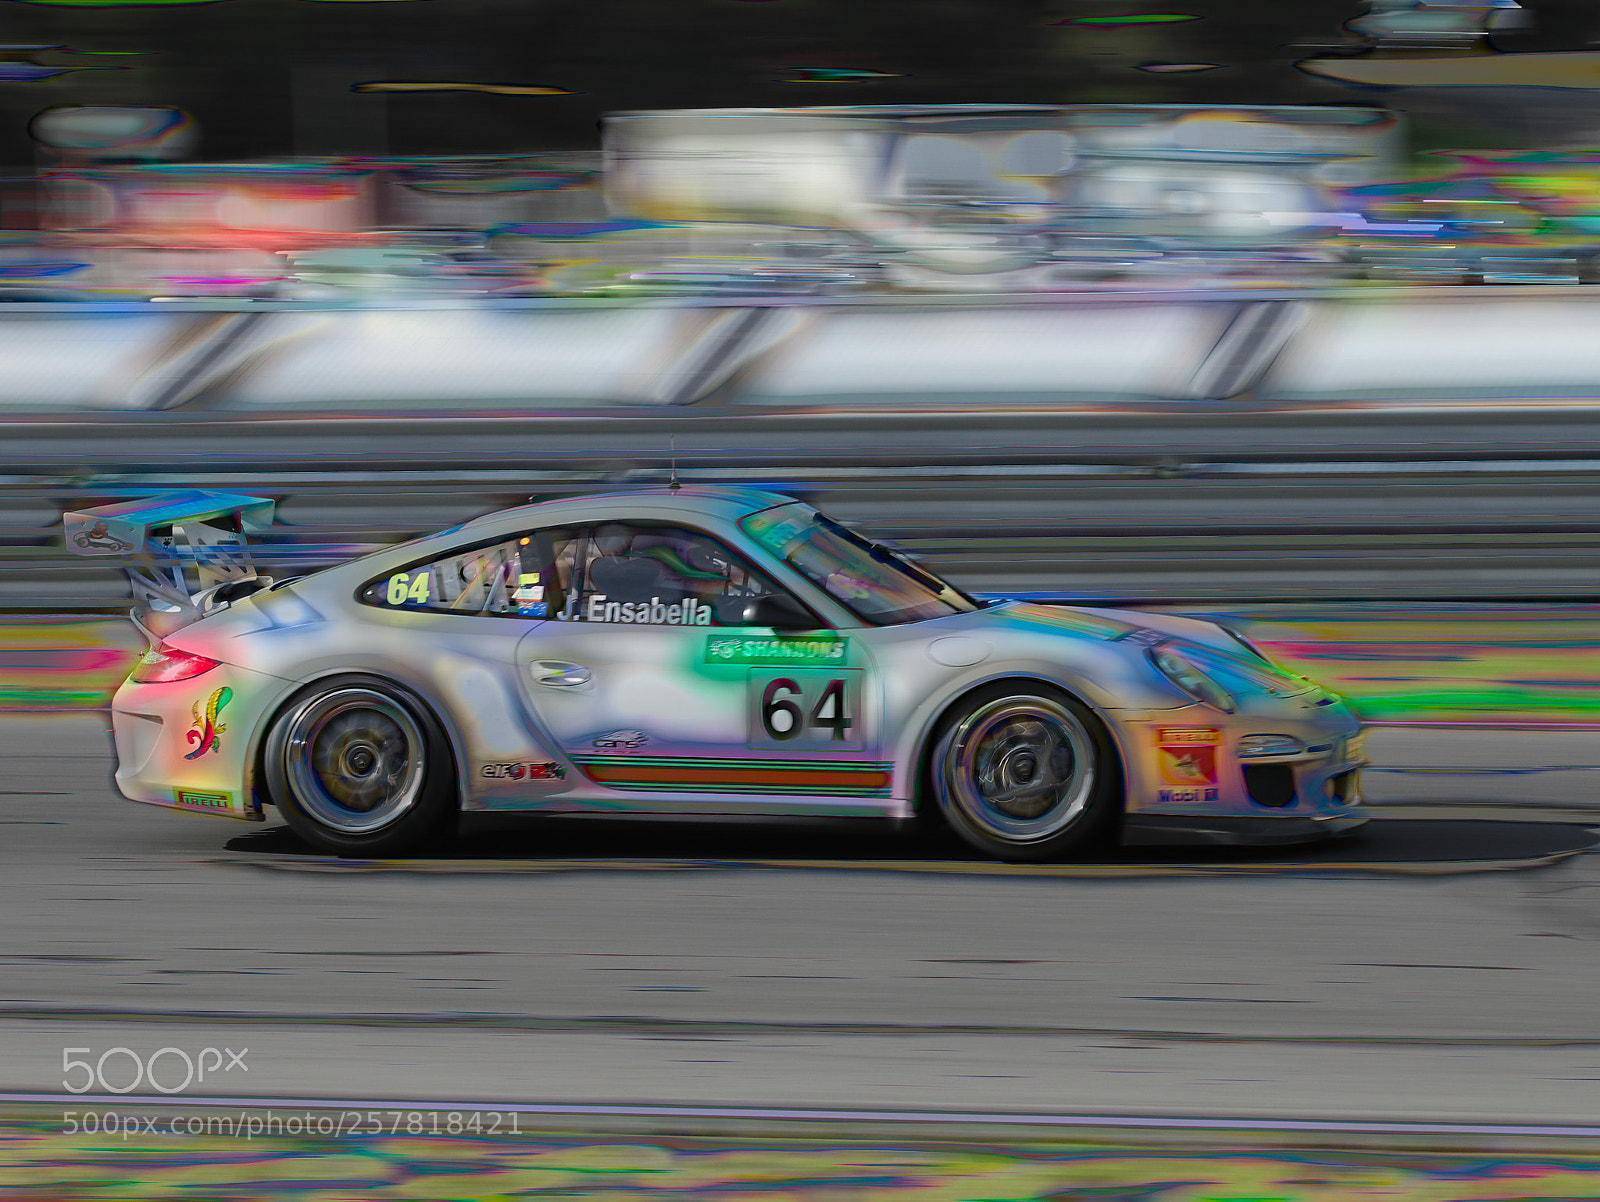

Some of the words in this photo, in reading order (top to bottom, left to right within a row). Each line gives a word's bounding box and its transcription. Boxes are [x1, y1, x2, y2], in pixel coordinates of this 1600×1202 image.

[386, 573, 431, 605] 64
[556, 594, 580, 621] J.
[587, 595, 712, 625] Ensabella
[762, 677, 852, 741] 64
[178, 791, 228, 808] PIRELLI
